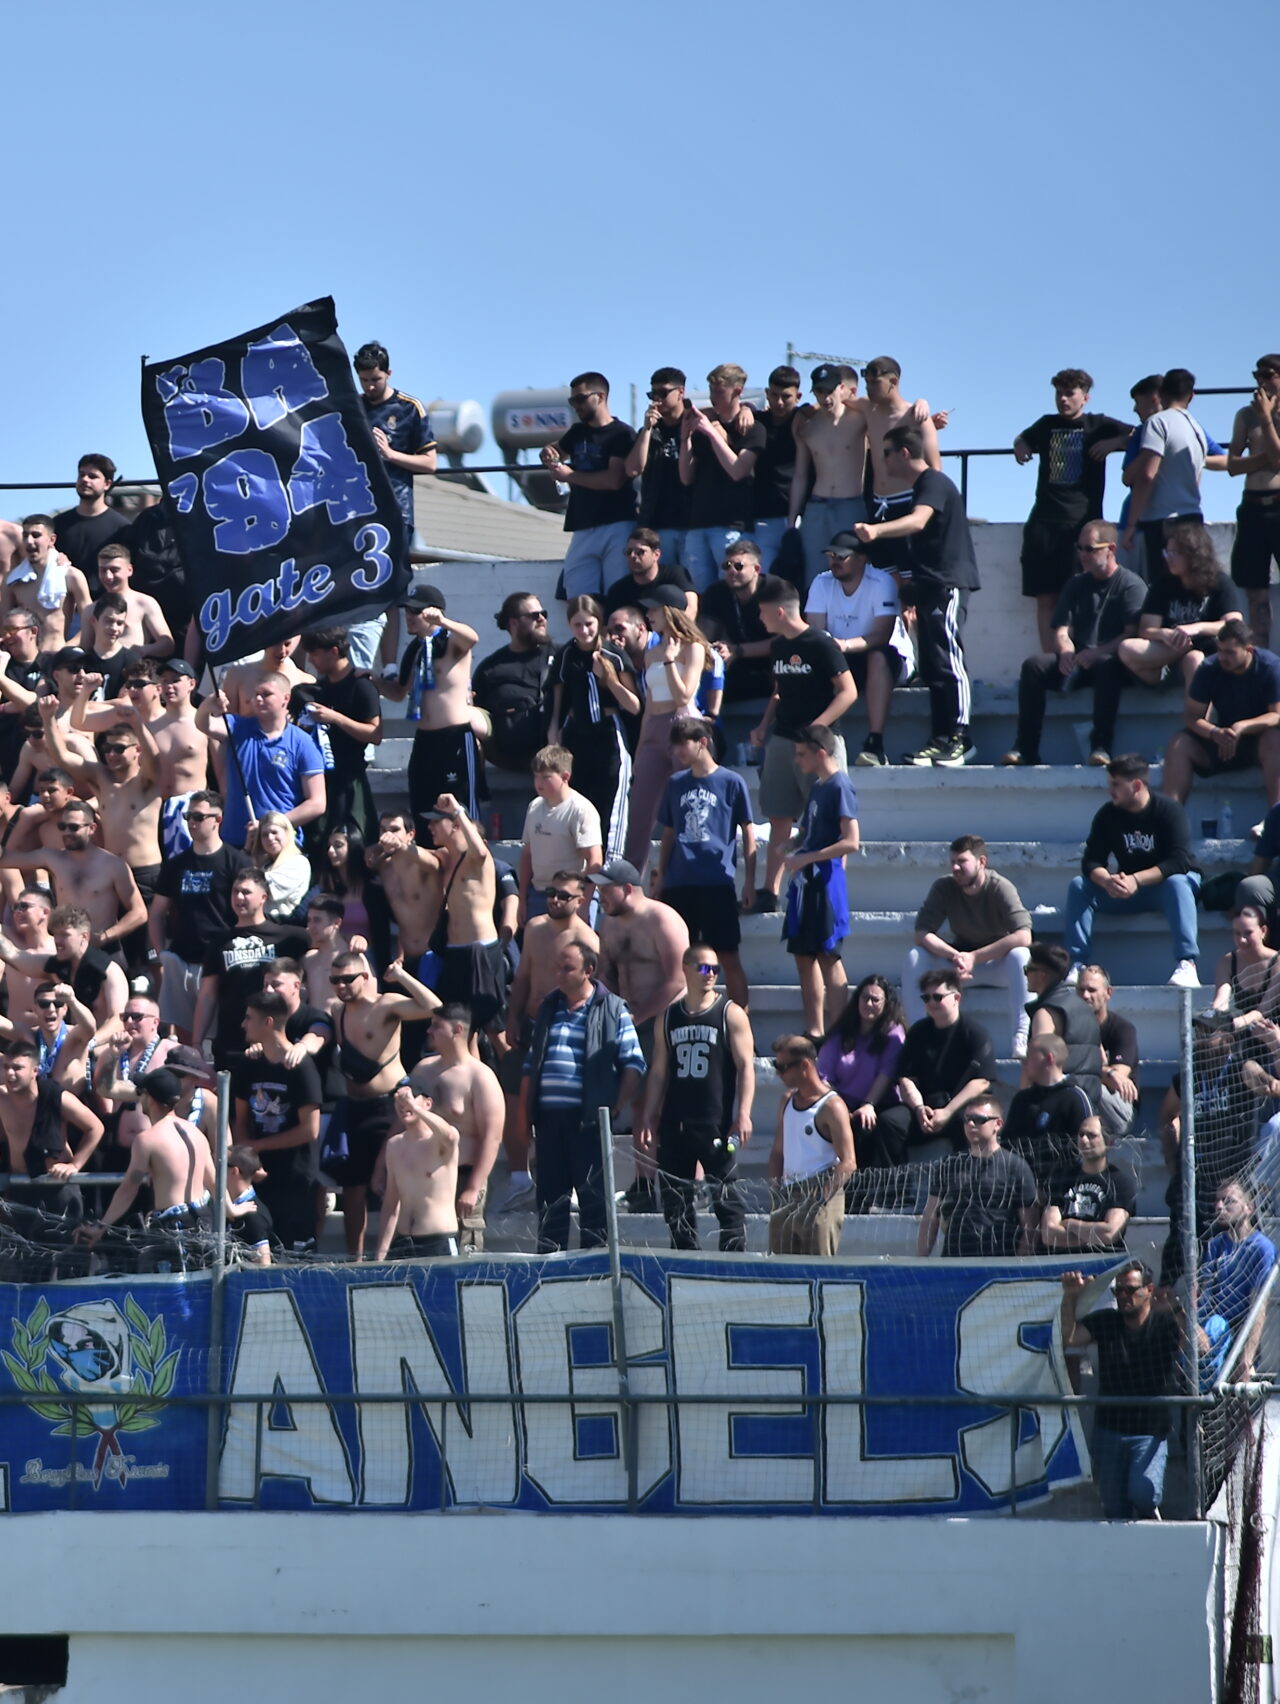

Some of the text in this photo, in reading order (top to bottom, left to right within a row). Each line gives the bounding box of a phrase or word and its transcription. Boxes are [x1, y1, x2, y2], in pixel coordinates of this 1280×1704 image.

[200, 523, 394, 653] gate 3
[698, 788, 718, 807] CLUB
[1123, 832, 1156, 853] VENOM
[222, 943, 276, 971] LONSDALE
[676, 1042, 710, 1078] 96
[219, 1271, 1069, 1507] ANGELS
